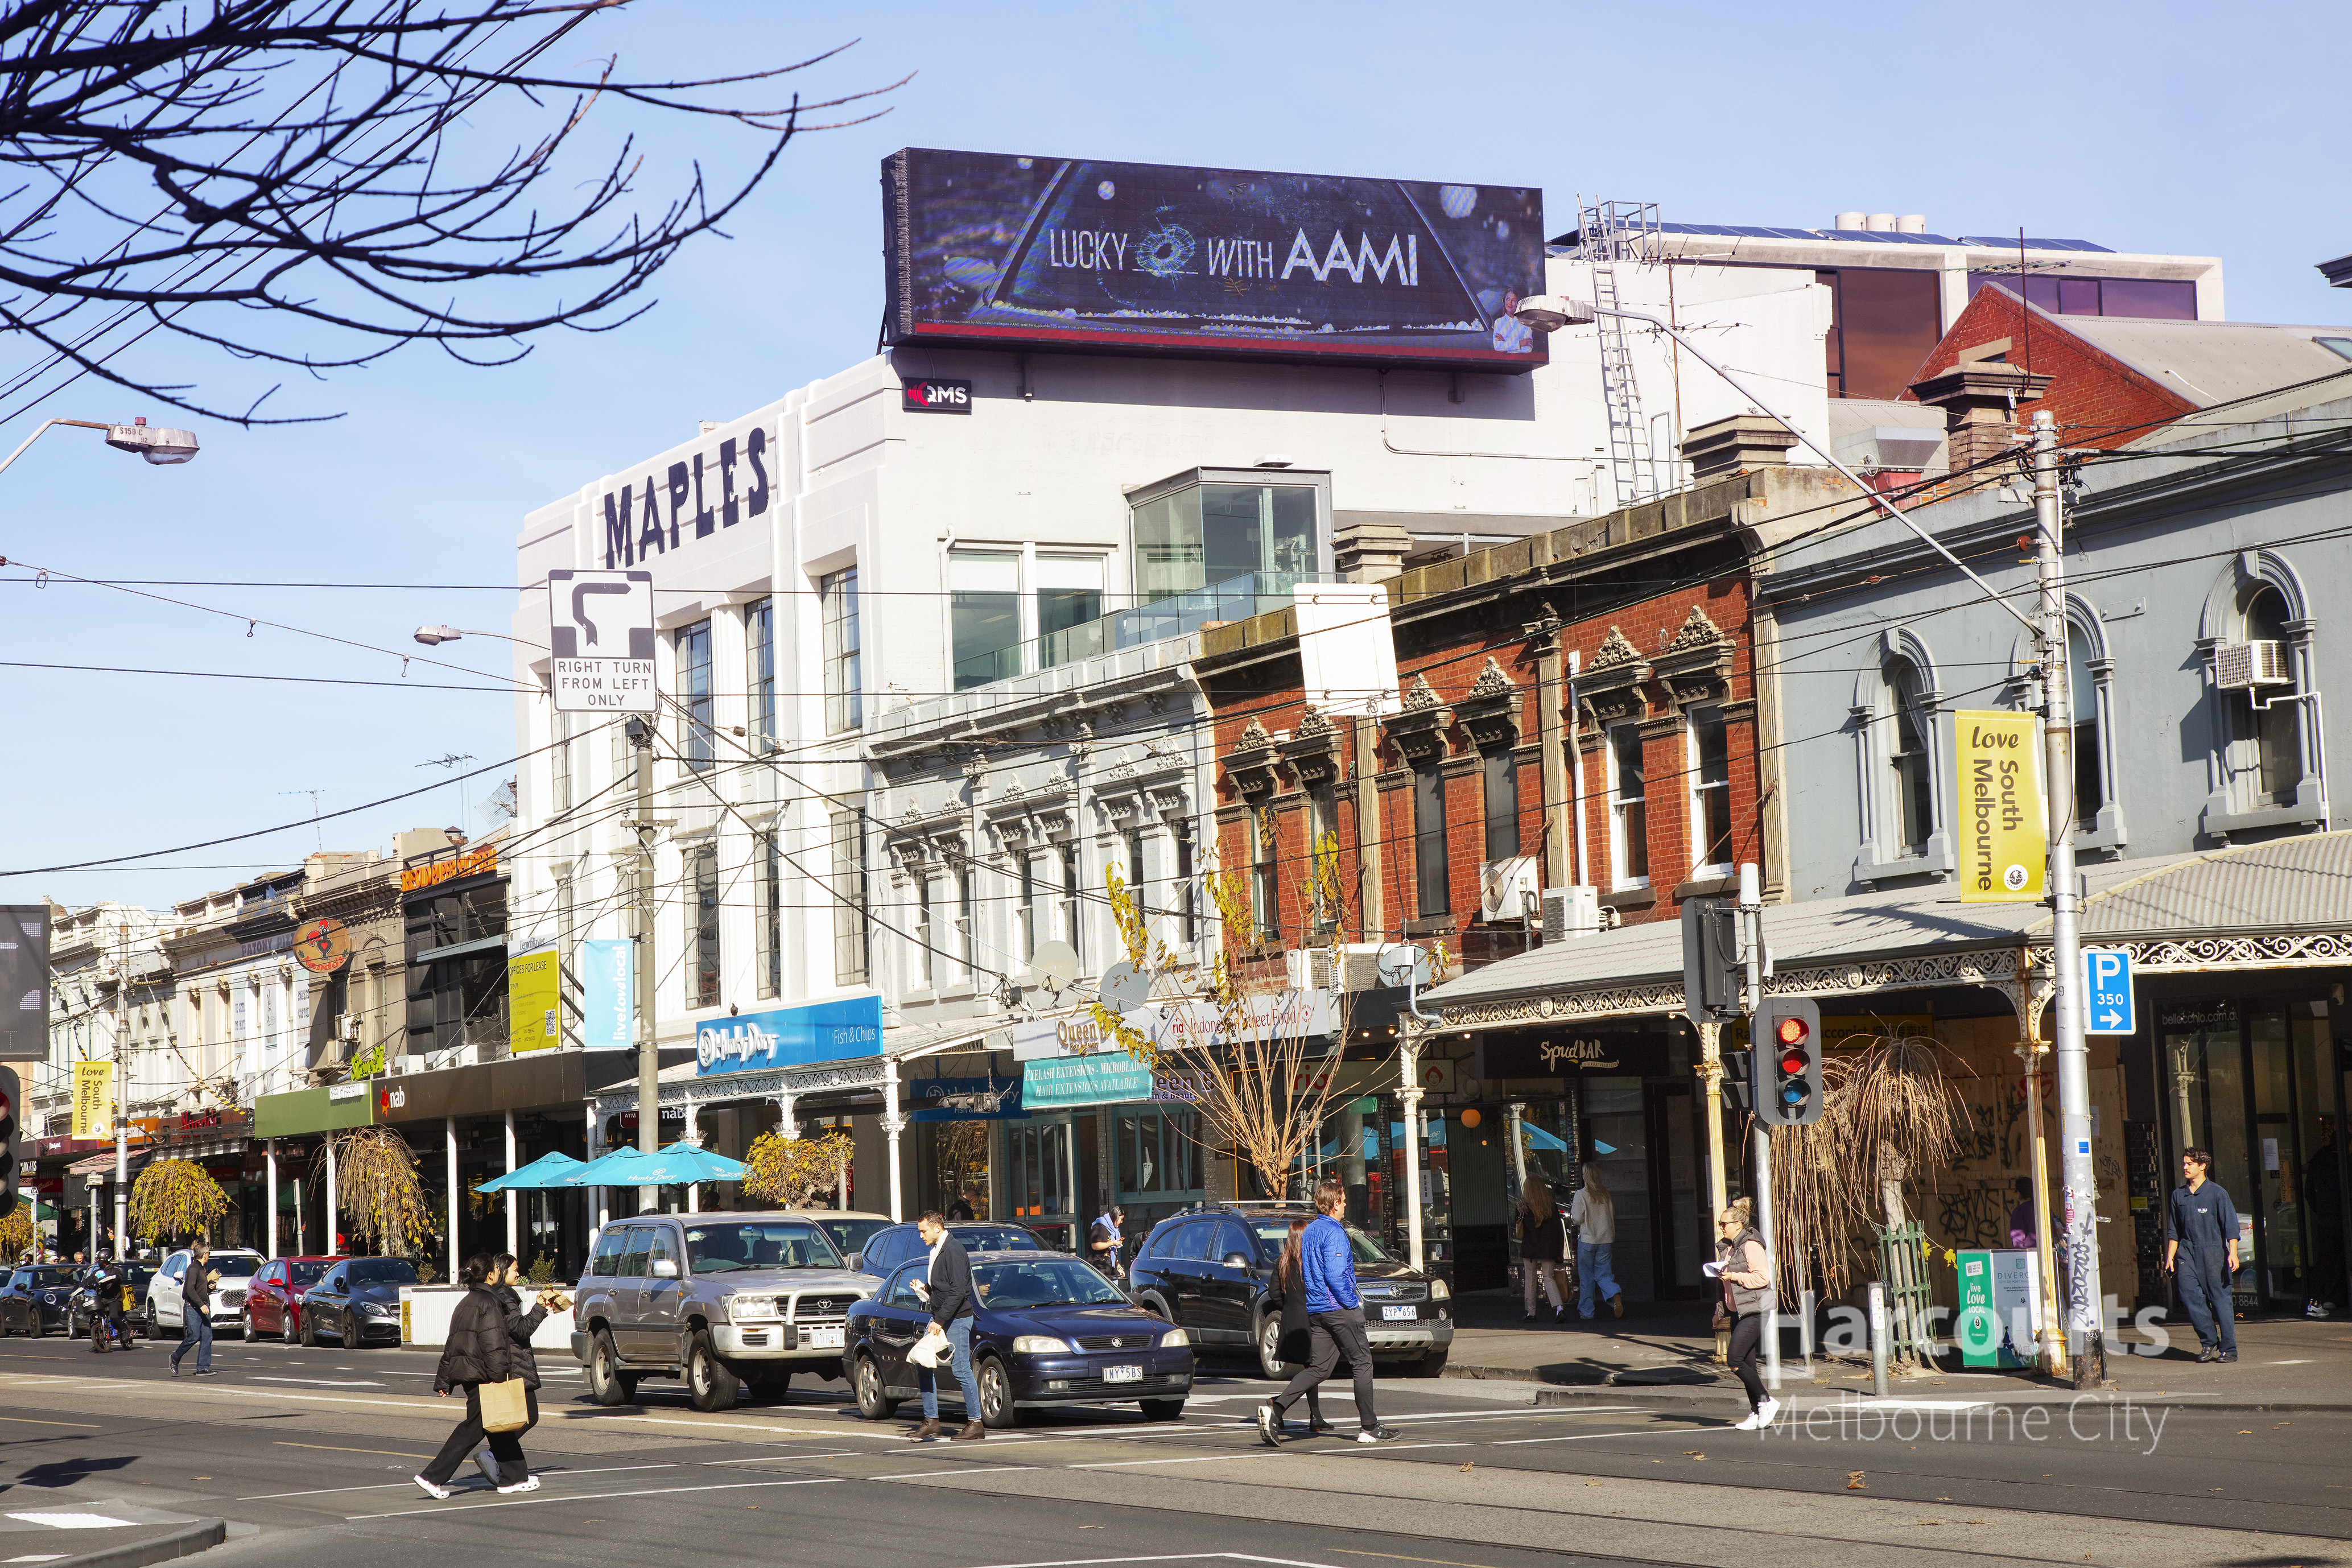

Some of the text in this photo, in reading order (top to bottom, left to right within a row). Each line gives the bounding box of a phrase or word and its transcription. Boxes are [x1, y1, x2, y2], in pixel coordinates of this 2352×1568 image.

[1050, 228, 1418, 286] LUCKY WITH AAMI
[917, 381, 967, 406] QMS
[604, 427, 769, 570] MAPLES
[558, 661, 651, 674] RIGHT TURN
[562, 677, 649, 690] FROM LEFT
[588, 694, 625, 707] ONLY
[1972, 725, 2019, 749] Love
[1999, 760, 2024, 831] South
[1973, 758, 1996, 892] Melbourne
[241, 938, 273, 956] PATONY
[302, 955, 345, 971] Nando's
[509, 964, 524, 976] OFFICES
[534, 960, 547, 972] LEASE
[2095, 954, 2120, 991] P
[2097, 993, 2124, 1006] 350
[1173, 1020, 1185, 1034] ria
[1273, 1006, 1297, 1025] Food
[715, 1022, 780, 1062] Hunky Dory
[834, 1025, 876, 1046] Fish & Chips
[1058, 1020, 1099, 1047] Queen
[1070, 1042, 1080, 1051] Skin
[81, 1067, 104, 1076] Love
[1025, 1067, 1054, 1082] EYELASH
[1056, 1064, 1095, 1078] EXTENSIONS
[1200, 1071, 1215, 1091] B
[1293, 1064, 1329, 1090] ria
[93, 1080, 102, 1109] South
[1035, 1077, 1138, 1097] HAIR EXTENSIONS AVAILABLE
[1170, 1092, 1198, 1101] Beauty
[80, 1080, 90, 1134] Melbourne
[390, 1086, 405, 1109] nab
[662, 1108, 684, 1120] nab
[38, 1179, 54, 1191] Grill'd
[1970, 1282, 1981, 1292] live
[2239, 1295, 2258, 1306] 8844
[815, 1335, 830, 1343] QDH
[1104, 1367, 1142, 1379] 1NY 5BS
